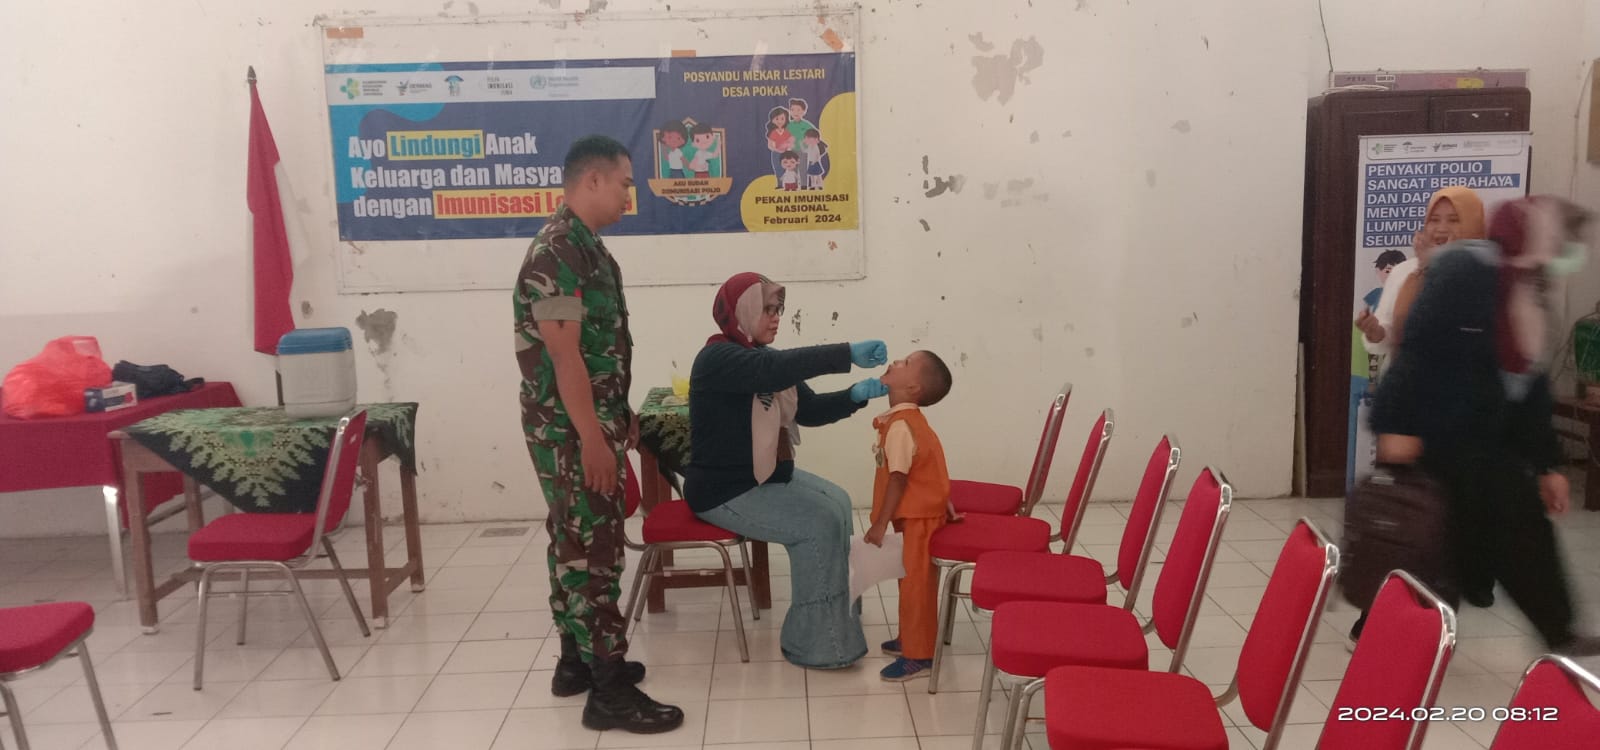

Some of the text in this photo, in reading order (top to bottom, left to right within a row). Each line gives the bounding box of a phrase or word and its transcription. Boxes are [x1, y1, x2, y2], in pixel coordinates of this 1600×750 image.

[684, 69, 825, 83] POSYANDU MEKAR LESTARI
[722, 85, 788, 98] DESA POKAK
[348, 132, 538, 160] Ayo Lindungi Anak
[350, 163, 564, 189] Keluarga dan Masya
[1368, 161, 1483, 177] PENYAKIT POLIO
[1367, 175, 1514, 191] SANGAT BERBAHAYA
[755, 193, 849, 205] PEKAN IMUNISASI
[1367, 191, 1431, 205] DAN DAP
[353, 195, 432, 219] dengan
[436, 192, 541, 215] Imunisasi
[775, 204, 829, 213] NASIONAL
[1366, 206, 1426, 219] MENYEB
[763, 214, 842, 225] Februari 2024
[1365, 234, 1414, 247] SEUMU
